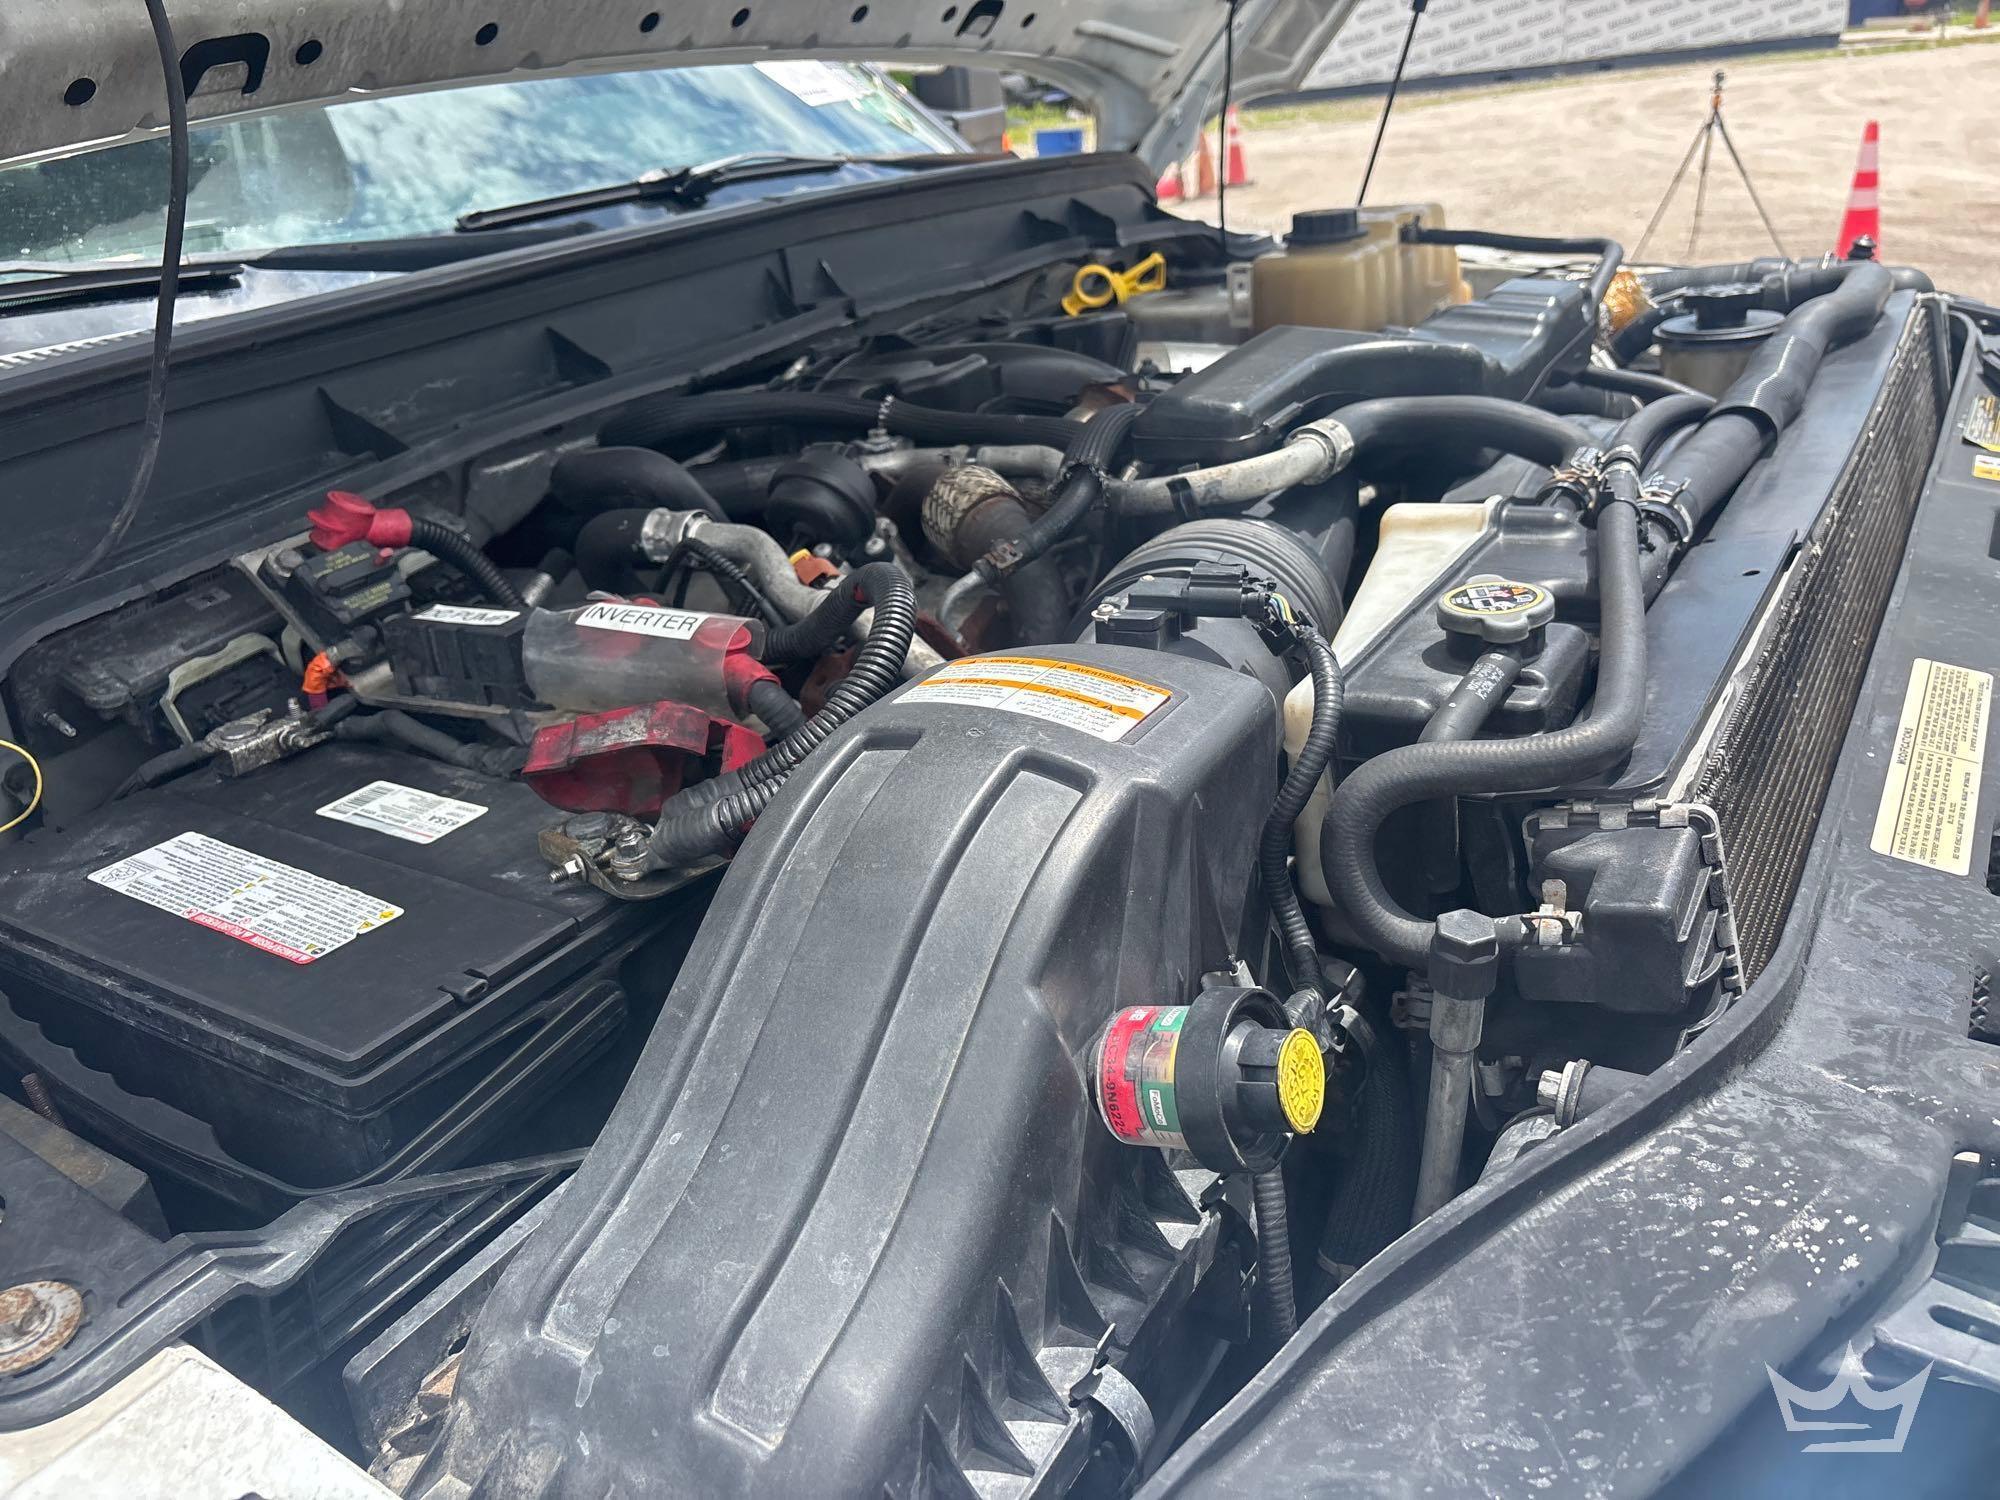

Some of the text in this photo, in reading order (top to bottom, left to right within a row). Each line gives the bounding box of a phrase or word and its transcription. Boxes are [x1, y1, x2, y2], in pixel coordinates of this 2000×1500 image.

[584, 604, 698, 632] INVERTER
[1074, 667, 1147, 688] AVERTISSEMENT
[1151, 1091, 1164, 1125] FoMoCo
